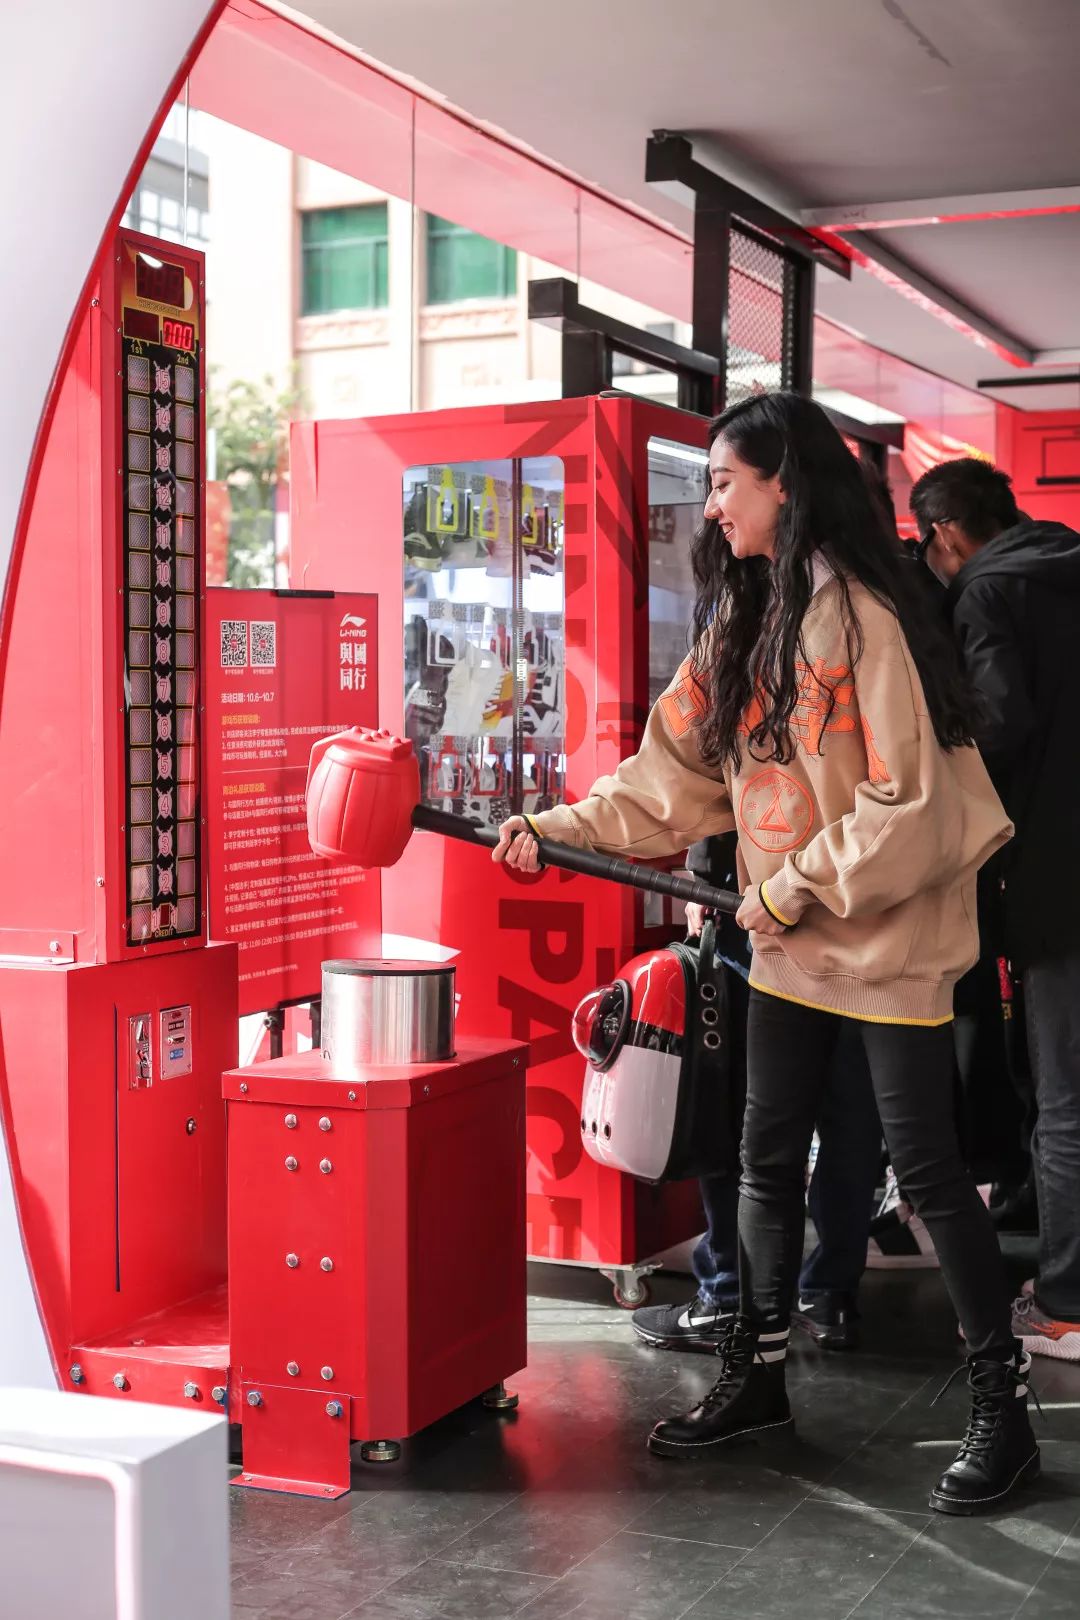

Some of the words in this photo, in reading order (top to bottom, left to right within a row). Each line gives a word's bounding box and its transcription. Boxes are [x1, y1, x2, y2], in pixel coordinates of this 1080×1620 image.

[131, 343, 143, 354] 1st
[177, 353, 189, 365] 2nd
[156, 369, 169, 390] 15
[156, 408, 169, 426] 14
[156, 447, 169, 468] 13
[156, 487, 170, 507] 12
[156, 525, 168, 545] 11
[156, 563, 169, 583] 10
[340, 668, 367, 690] 同行
[154, 928, 173, 937] CREDIT
